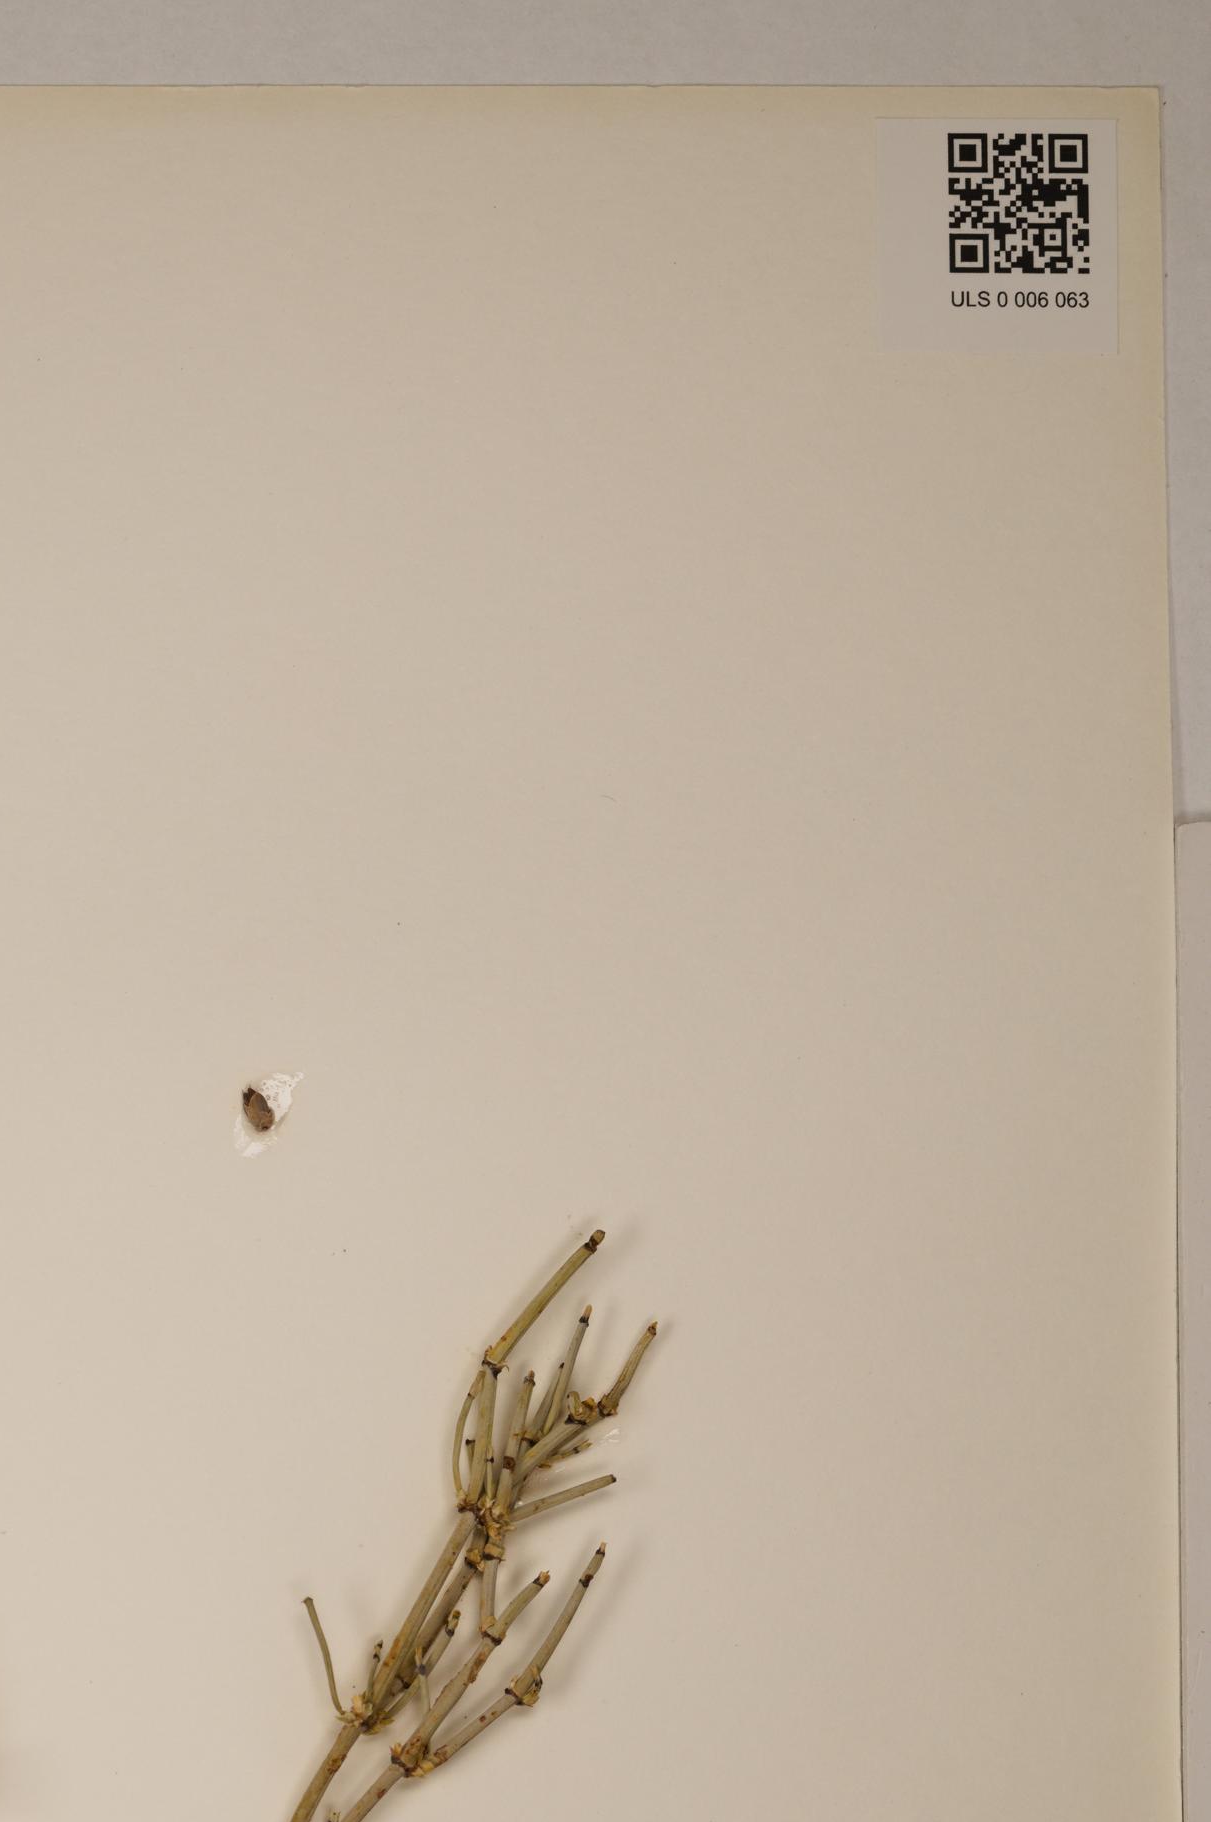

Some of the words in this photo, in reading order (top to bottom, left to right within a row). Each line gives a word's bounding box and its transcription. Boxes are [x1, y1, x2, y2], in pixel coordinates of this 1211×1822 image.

[951, 290, 991, 308] ULS
[996, 290, 1009, 308] 0
[1014, 291, 1049, 309] 006
[1055, 291, 1090, 309] 063
